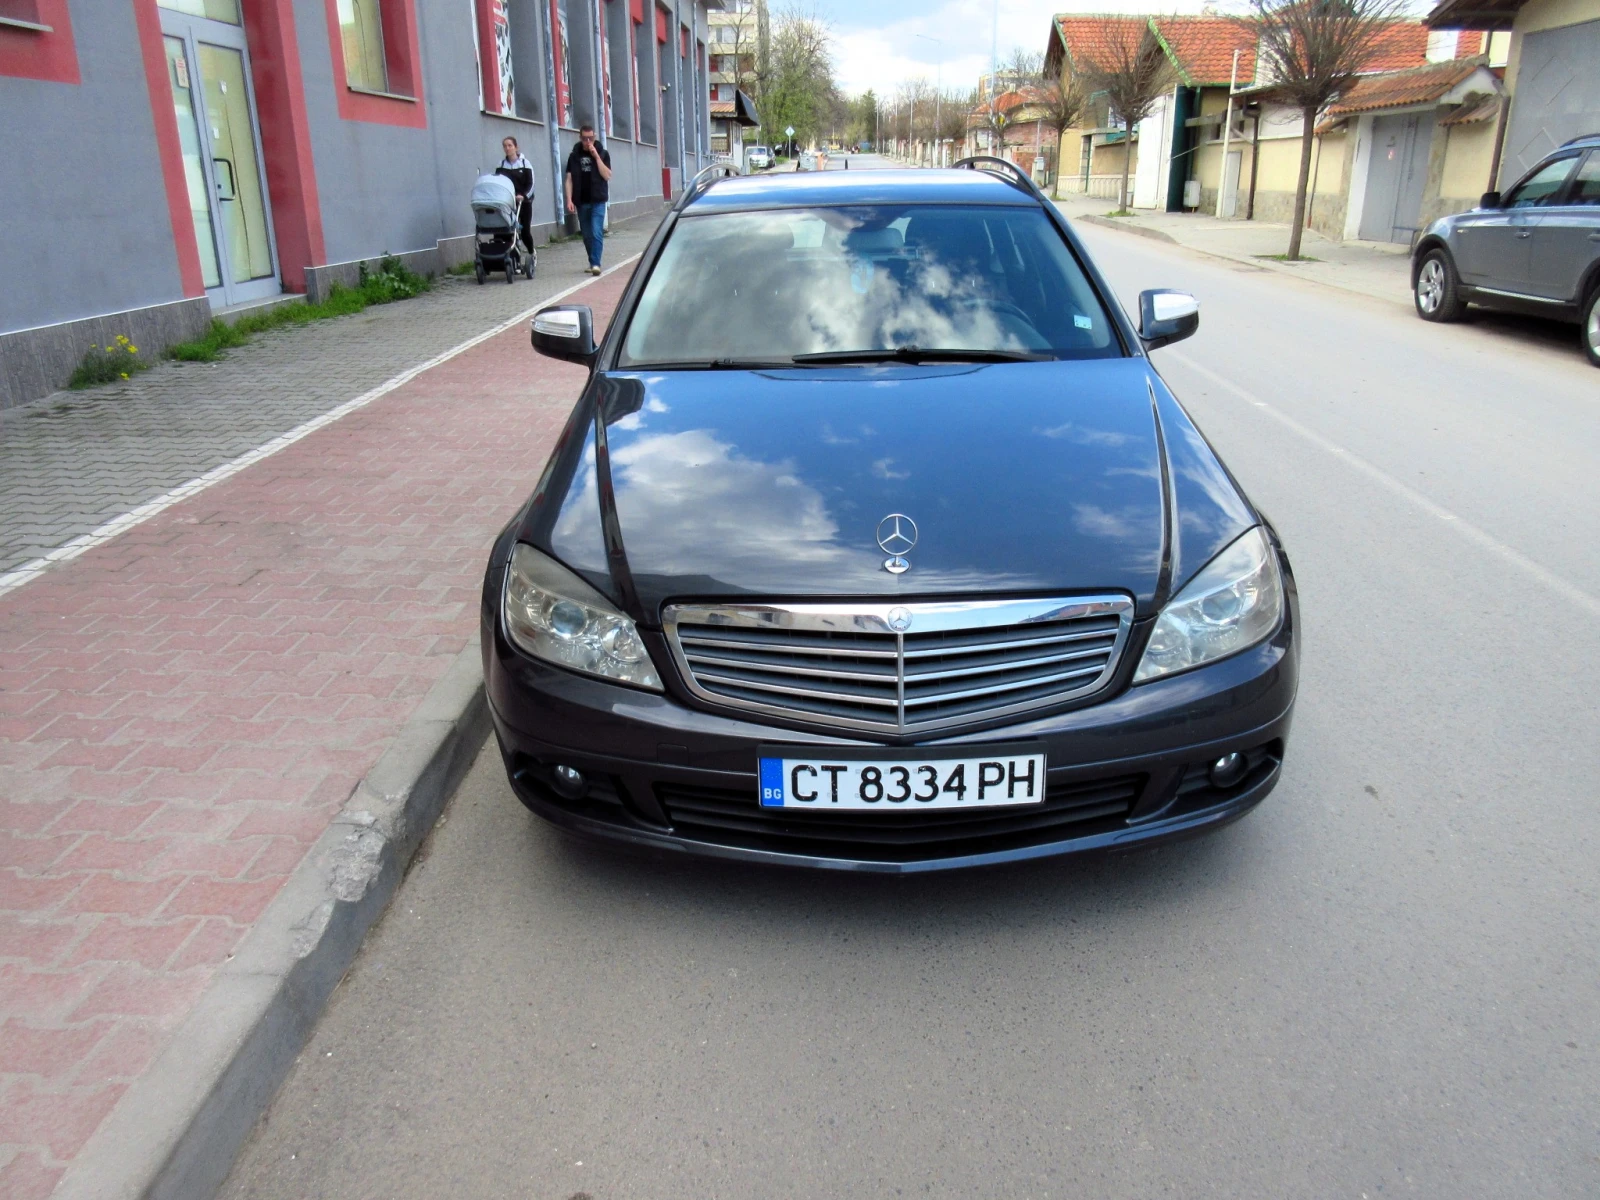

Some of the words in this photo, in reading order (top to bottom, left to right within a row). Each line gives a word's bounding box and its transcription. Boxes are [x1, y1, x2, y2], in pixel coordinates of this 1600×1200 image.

[764, 788, 782, 800] BG
[791, 764, 848, 802] CT
[858, 764, 967, 803] 8334
[977, 759, 1035, 800] PH
